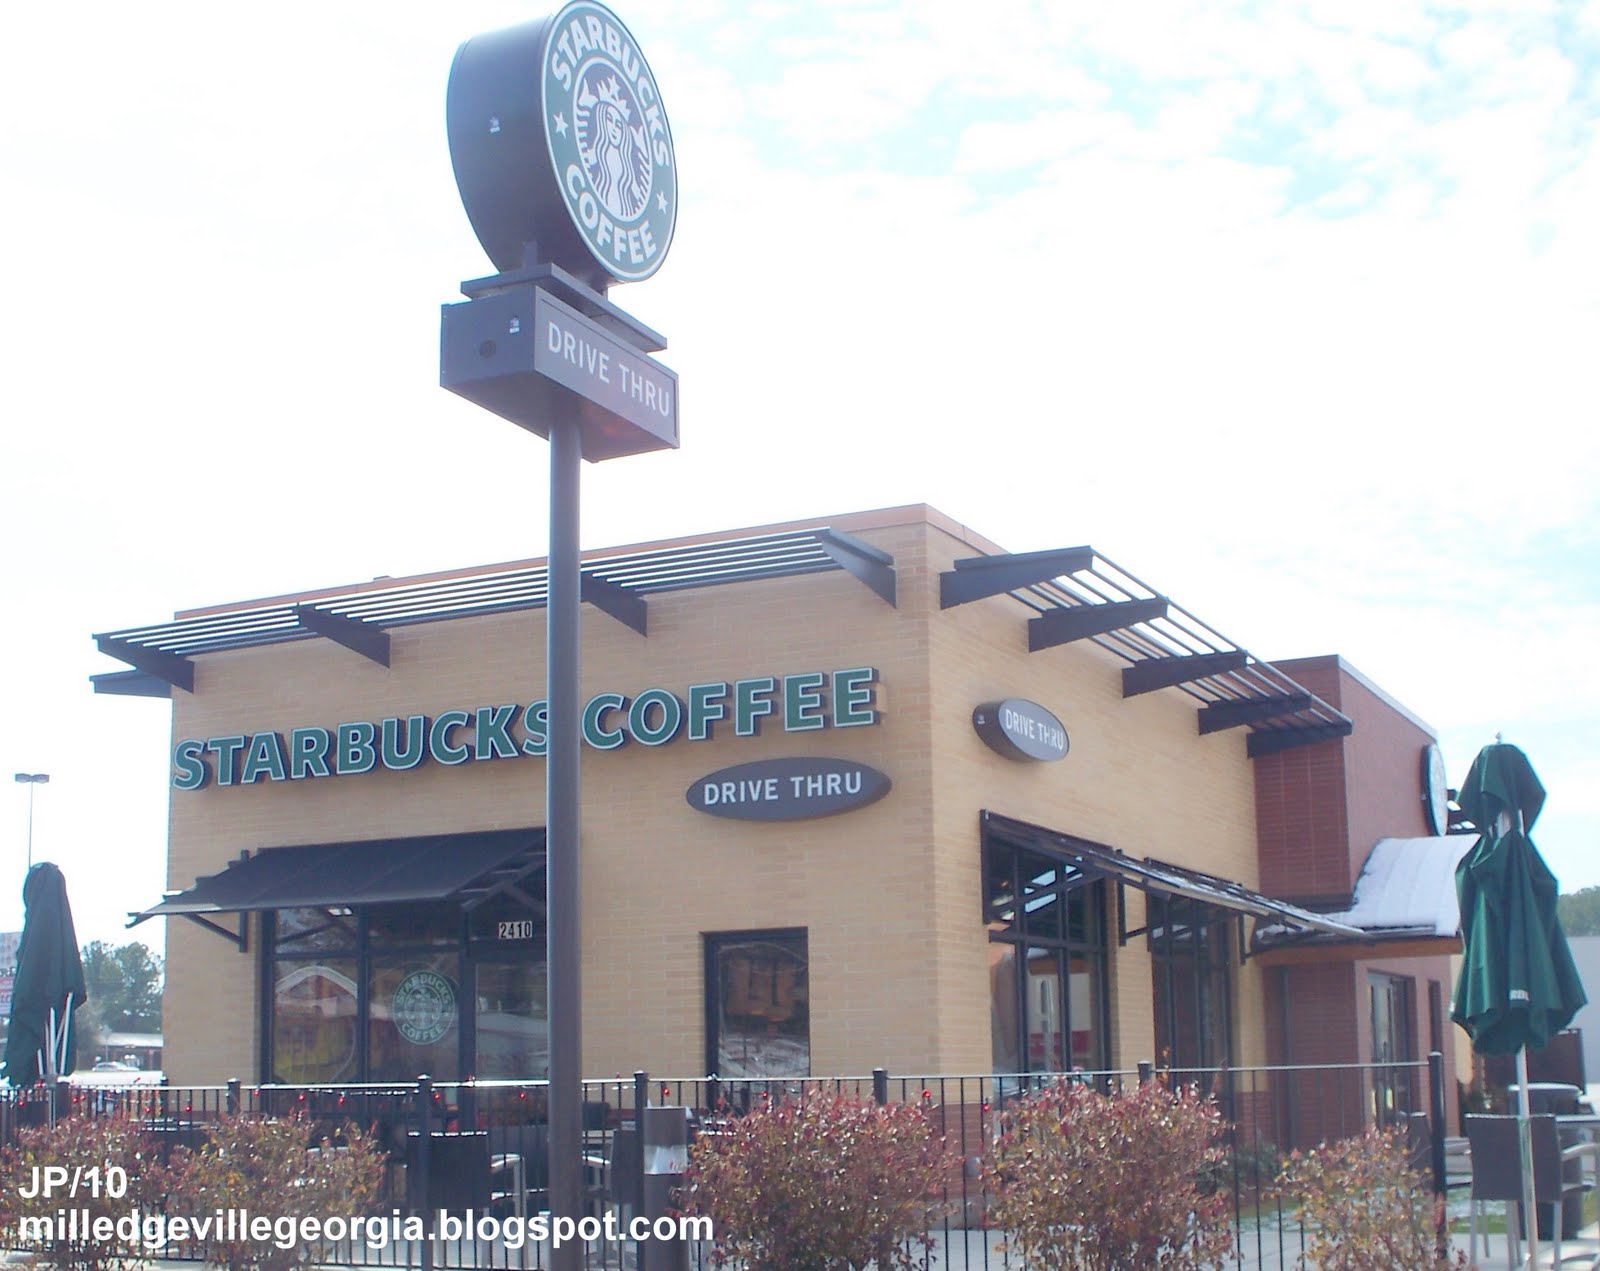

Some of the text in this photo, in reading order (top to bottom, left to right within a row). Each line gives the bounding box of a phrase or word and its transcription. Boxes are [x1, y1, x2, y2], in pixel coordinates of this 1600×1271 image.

[552, 16, 669, 168] STARBUCKS
[566, 164, 656, 264] COFFEE
[549, 321, 670, 417] DRIVE THRU
[173, 667, 876, 790] STARBUCKS COFFEE
[1005, 708, 1064, 750] DRIVE THRU
[704, 771, 862, 805] DRIVE THRU
[500, 922, 532, 938] 2410
[396, 973, 452, 1005] STARBUCKS
[402, 1023, 445, 1041] COFFEE
